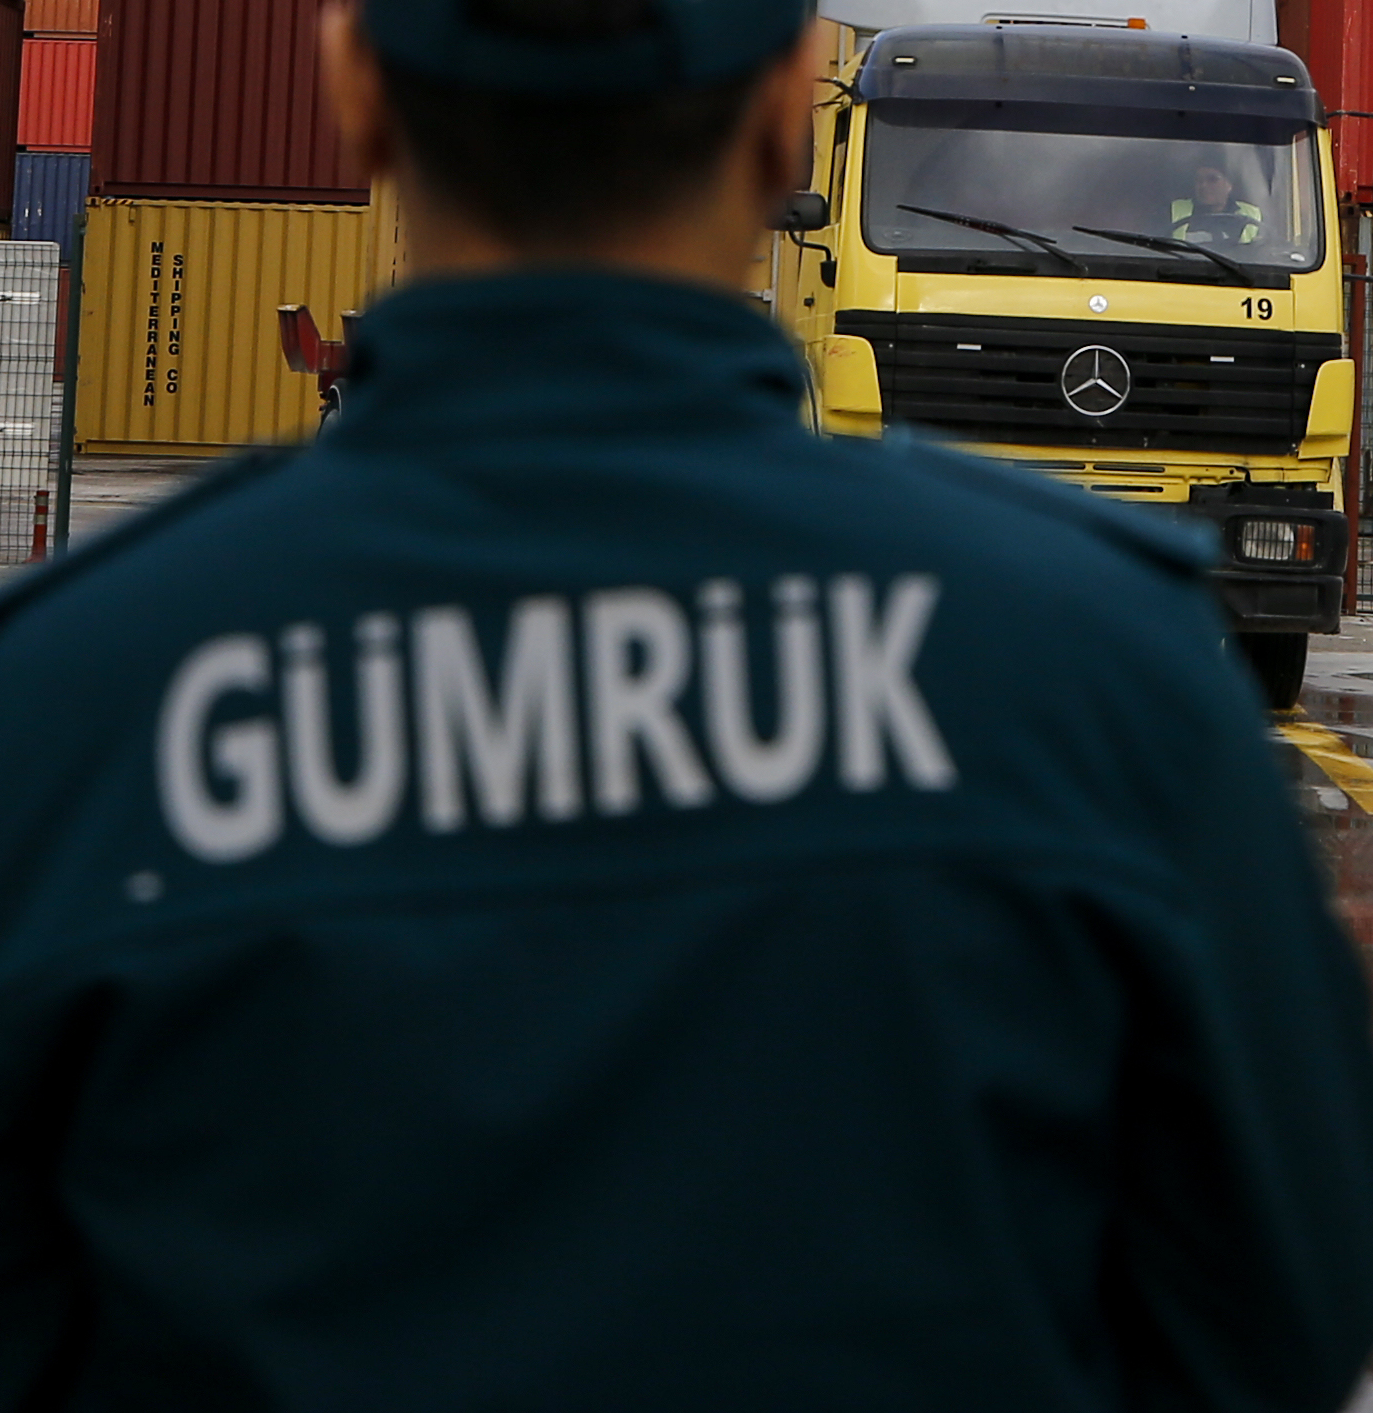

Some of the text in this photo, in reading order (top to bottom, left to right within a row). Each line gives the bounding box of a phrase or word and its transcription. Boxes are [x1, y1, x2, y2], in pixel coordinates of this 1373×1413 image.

[143, 242, 163, 406] MEDITERRANEAN
[166, 255, 183, 393] SHIPPING CO
[1240, 298, 1273, 321] 19
[156, 574, 959, 862] GÜMRÜK
